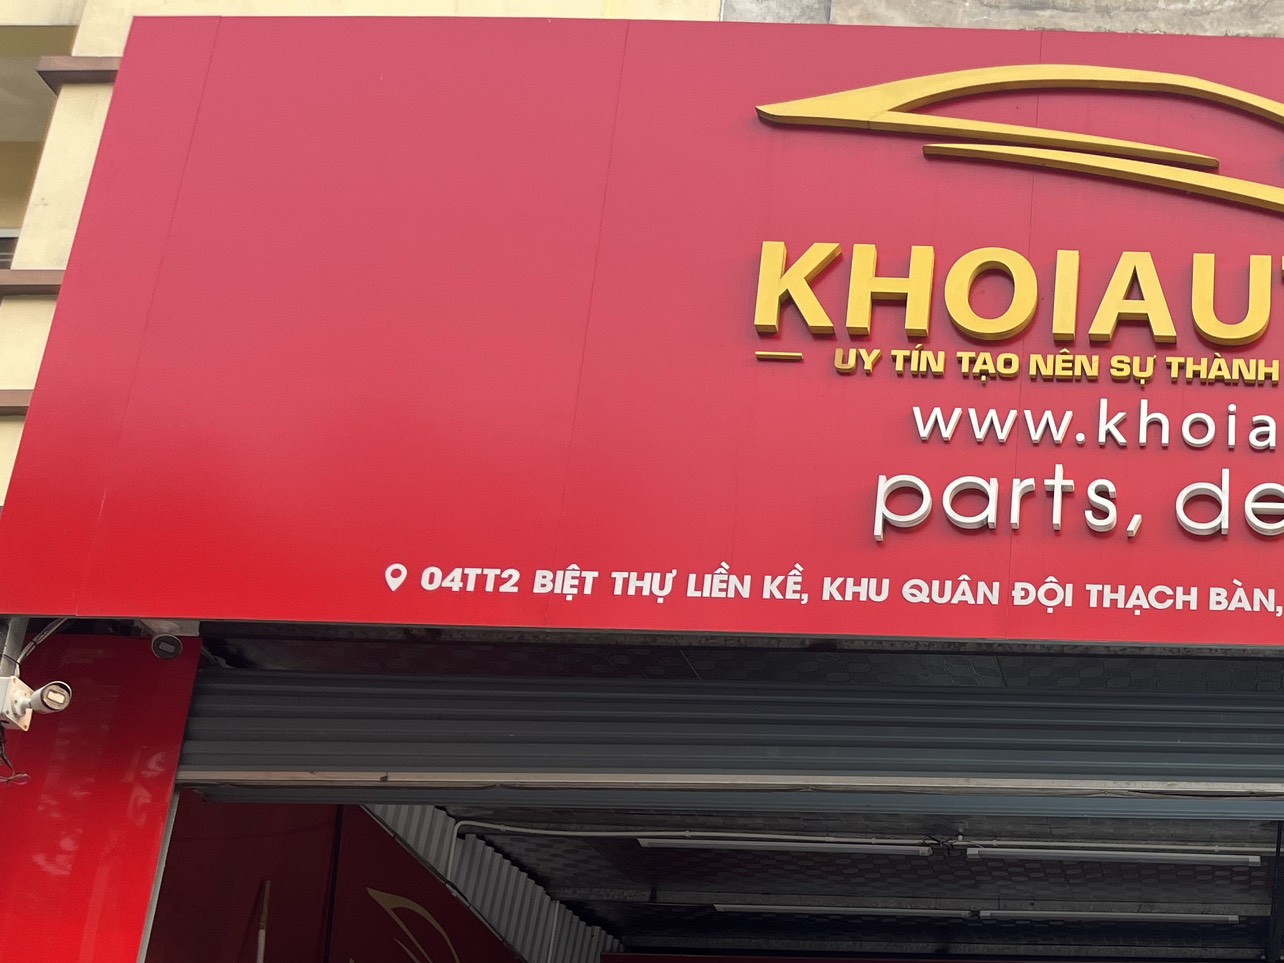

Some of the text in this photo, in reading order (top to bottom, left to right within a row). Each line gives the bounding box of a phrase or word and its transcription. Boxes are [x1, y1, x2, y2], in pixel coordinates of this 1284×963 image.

[834, 348, 882, 376] UY
[890, 343, 945, 379] TÍN
[956, 351, 1020, 386] TẠO
[1029, 348, 1100, 381] NÊN
[1110, 354, 1157, 387] SỰ
[1165, 352, 1280, 386] THÀNH
[873, 463, 1142, 542] parts,
[420, 566, 521, 593] 04TT2
[532, 563, 599, 601] BIỆT
[611, 569, 677, 604] THỰ
[686, 560, 751, 599] LIỀN
[762, 562, 809, 604] KỀ,
[821, 576, 890, 602] KHU
[902, 573, 1000, 605] QUÂN
[1011, 575, 1073, 614] ĐỘI
[1085, 583, 1198, 616] THẠCH
[1208, 578, 1284, 617] BÀN,
